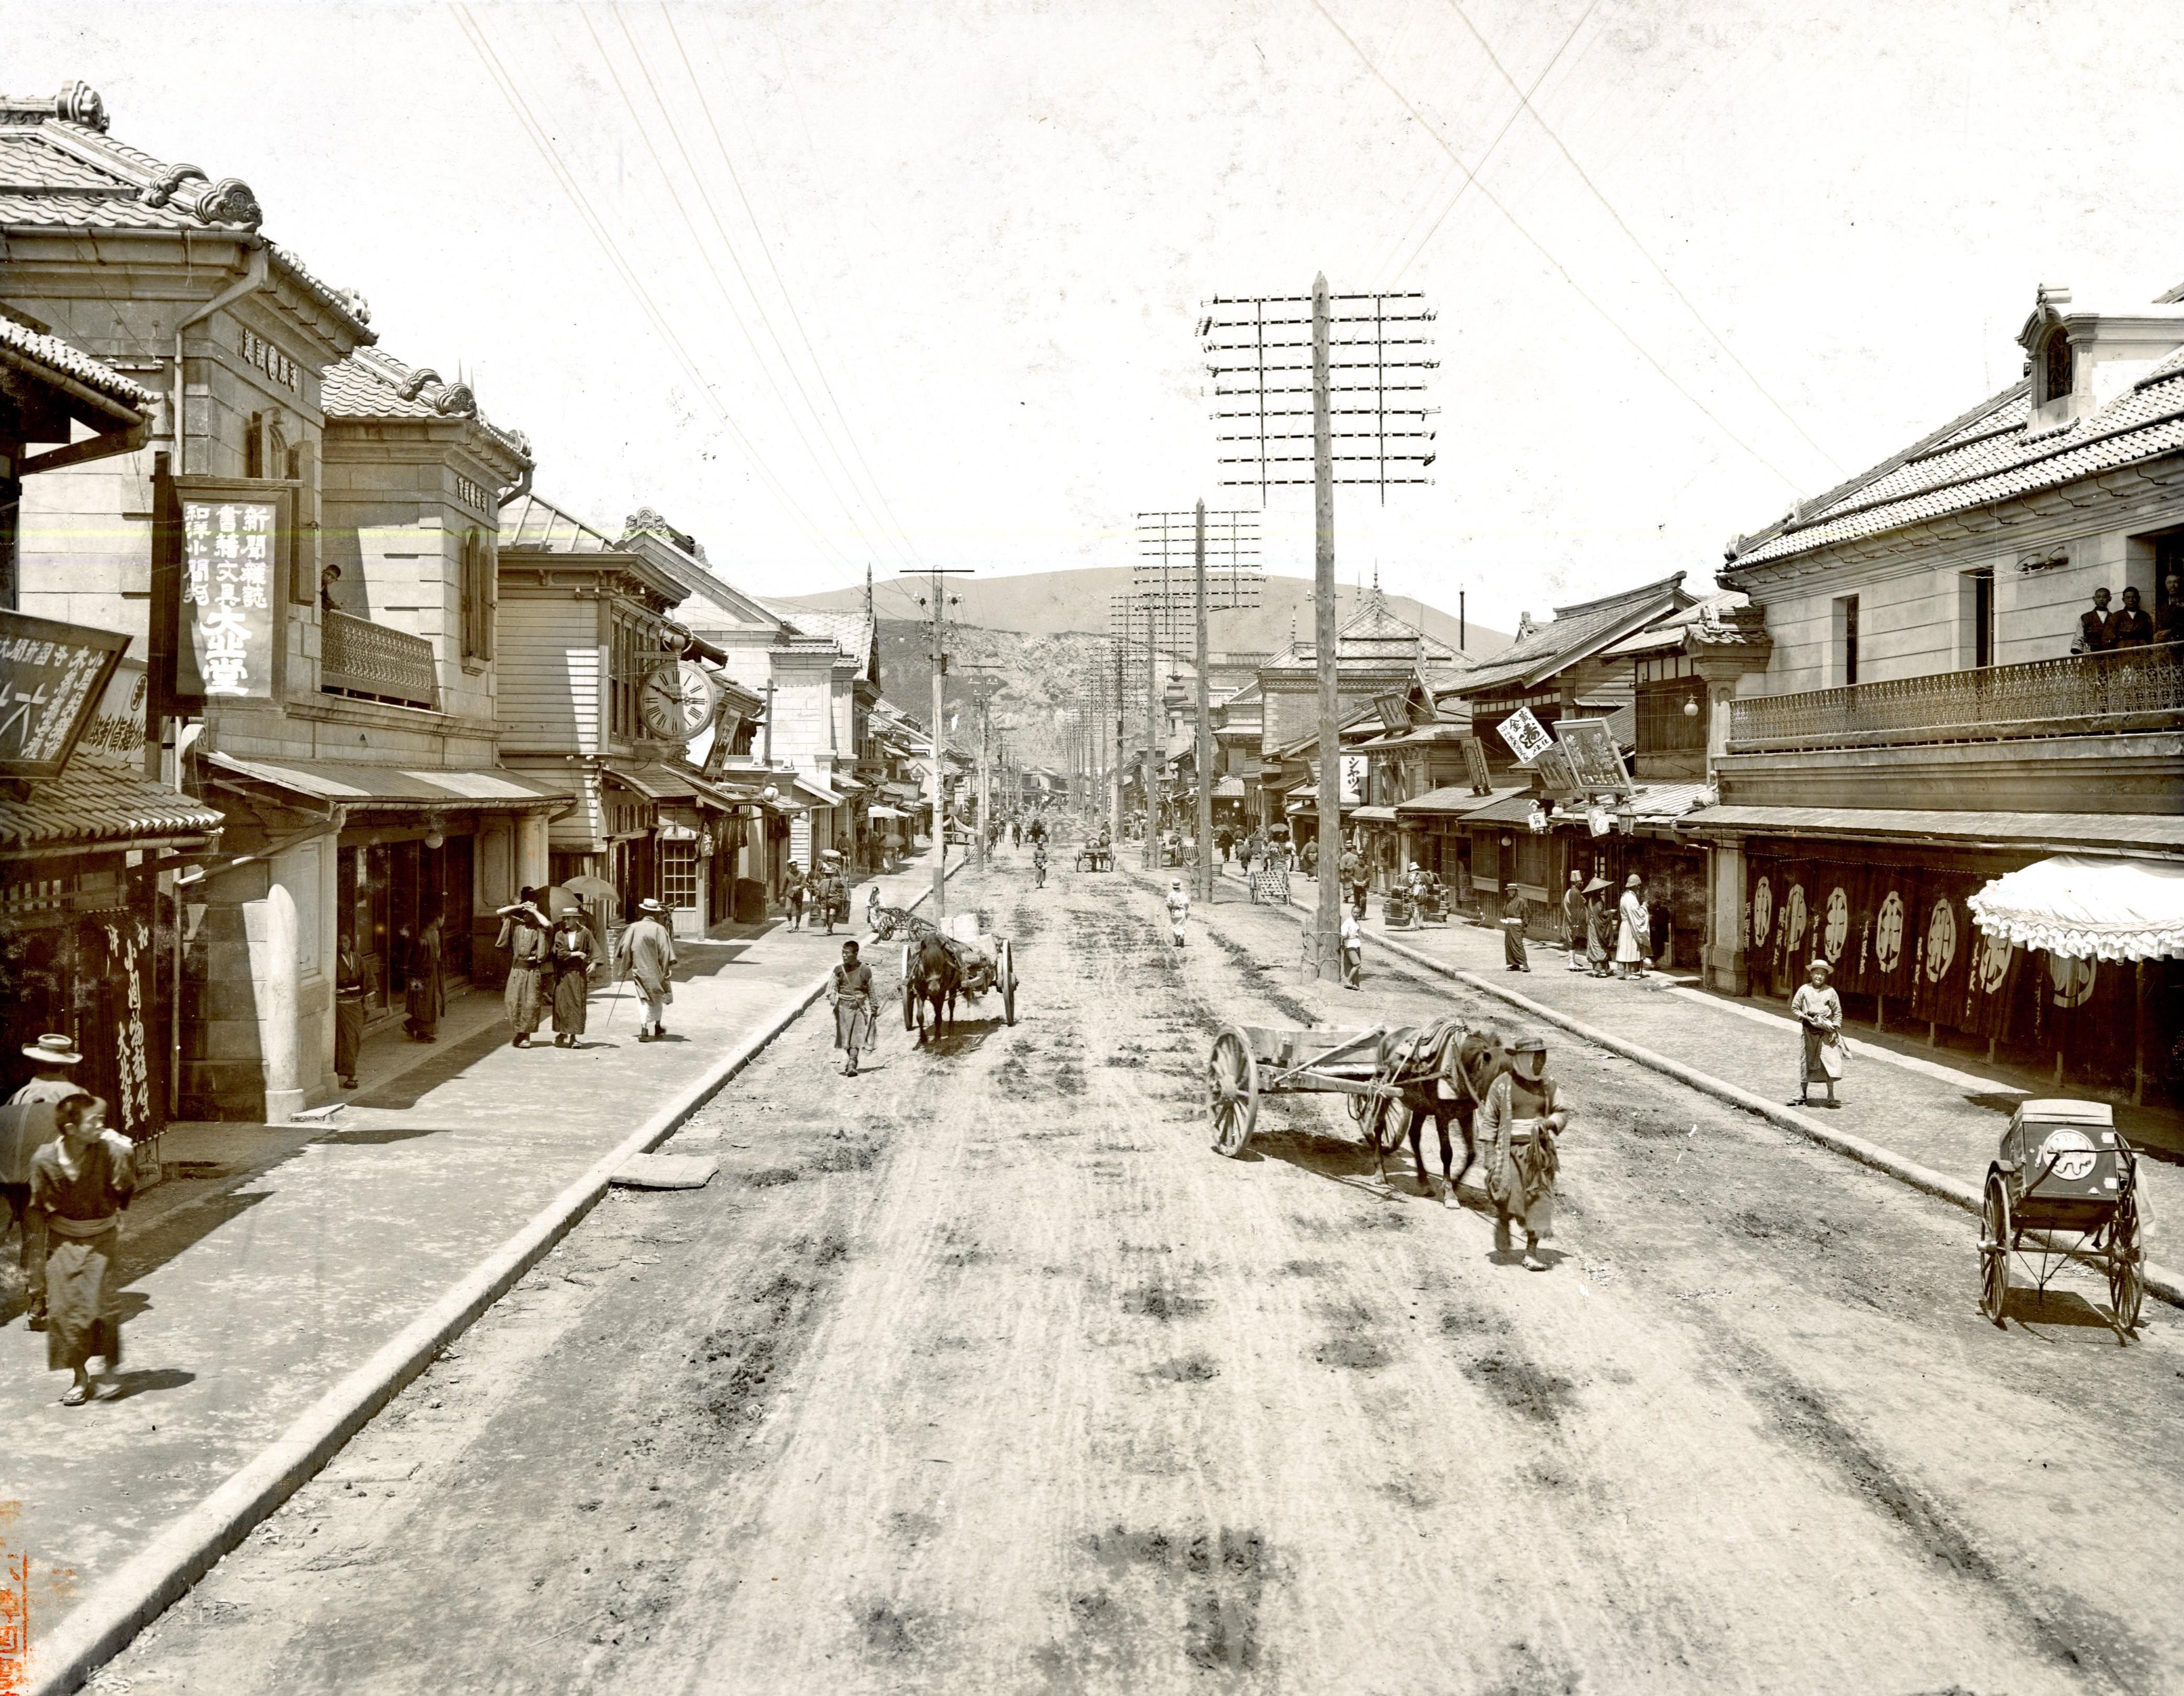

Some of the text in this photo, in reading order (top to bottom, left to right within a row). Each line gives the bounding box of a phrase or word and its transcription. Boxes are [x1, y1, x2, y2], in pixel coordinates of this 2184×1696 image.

[183, 504, 211, 606] 和洋小間物
[214, 504, 242, 606] 書籍文具
[199, 604, 252, 696] 大北堂
[1532, 815, 1542, 826] 仁丹
